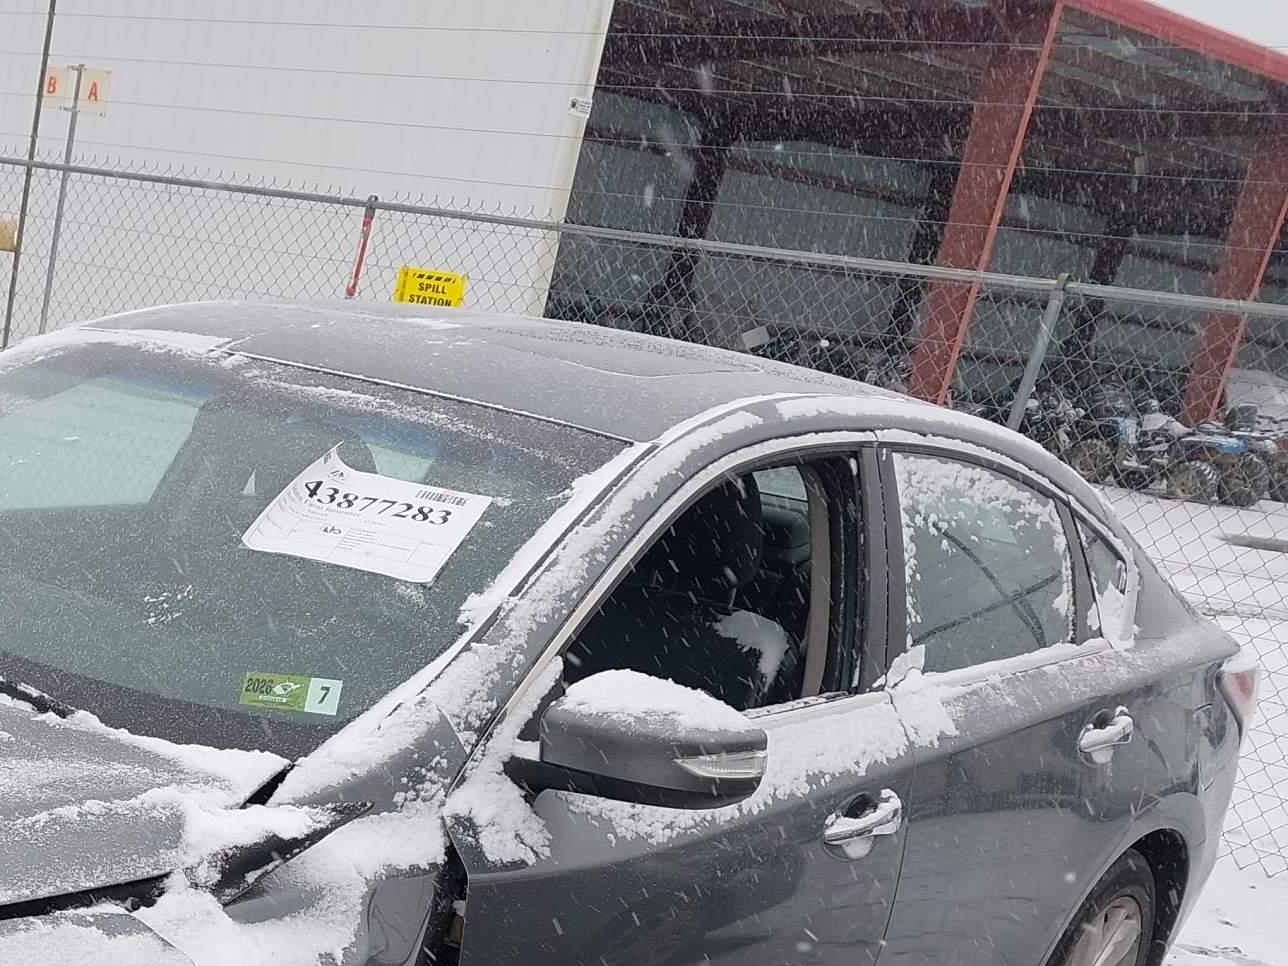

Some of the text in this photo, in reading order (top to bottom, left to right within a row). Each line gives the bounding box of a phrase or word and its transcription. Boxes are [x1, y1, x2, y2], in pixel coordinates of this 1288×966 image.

[47, 76, 57, 94] B
[88, 82, 98, 101] A
[418, 282, 446, 295] SPILL
[408, 294, 452, 306] STATION
[304, 480, 452, 526] 43877283
[245, 678, 274, 695] 2026
[318, 686, 330, 704] 7
